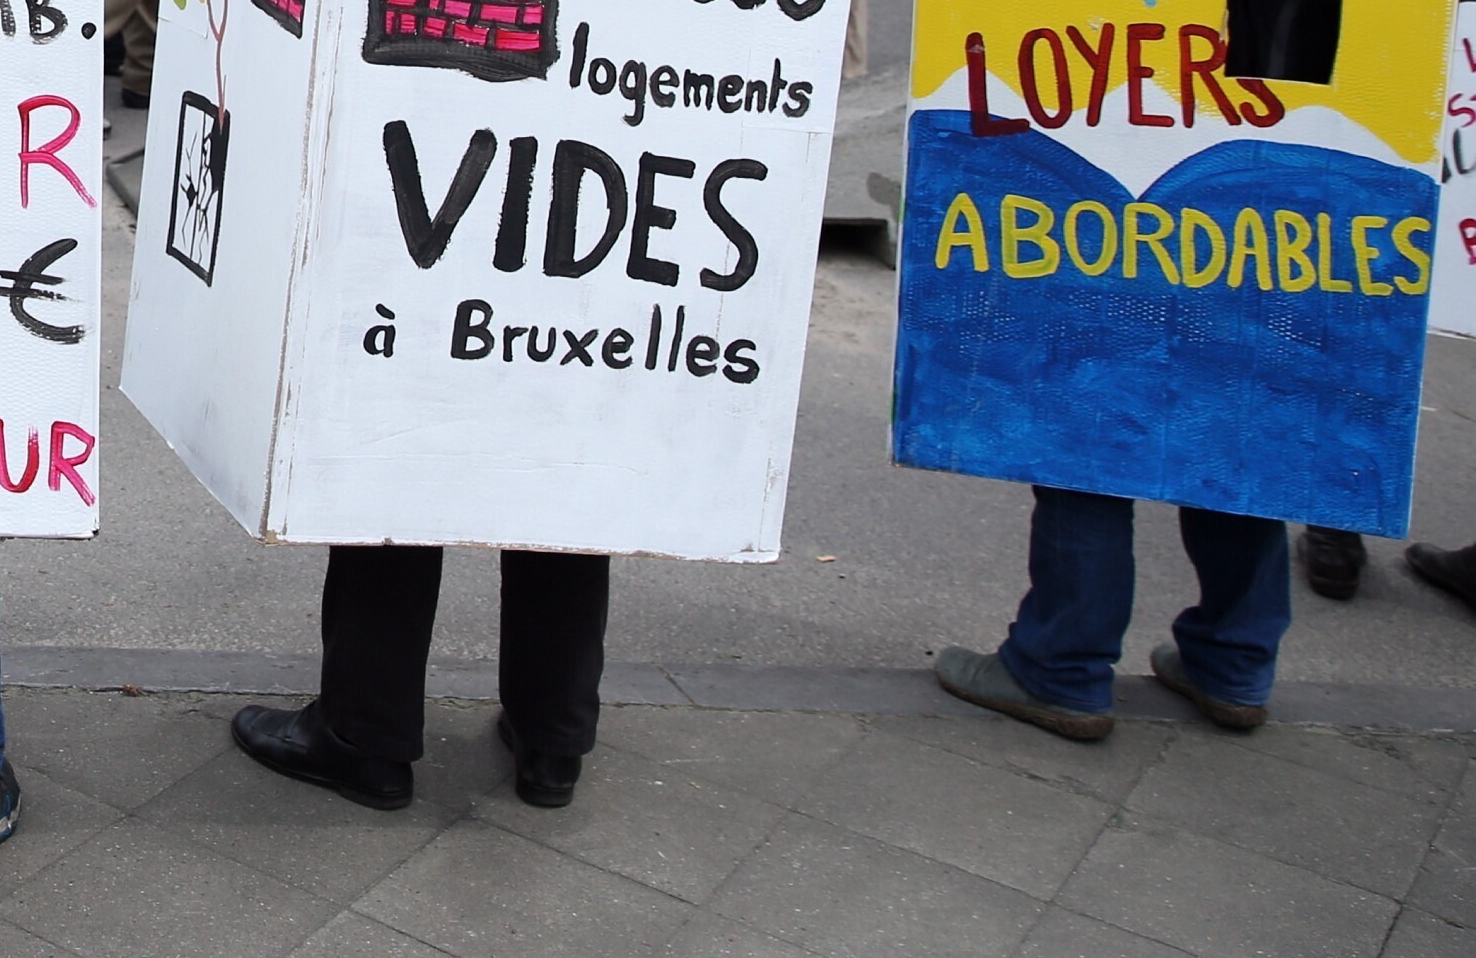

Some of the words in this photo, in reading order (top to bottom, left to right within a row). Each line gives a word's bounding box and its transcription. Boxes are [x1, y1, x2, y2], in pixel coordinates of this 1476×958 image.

[570, 22, 813, 126] logements
[383, 120, 768, 291] VIDES
[936, 193, 1431, 296] ABORDABLES
[363, 304, 395, 359] à
[451, 299, 760, 384] Bruxelles
